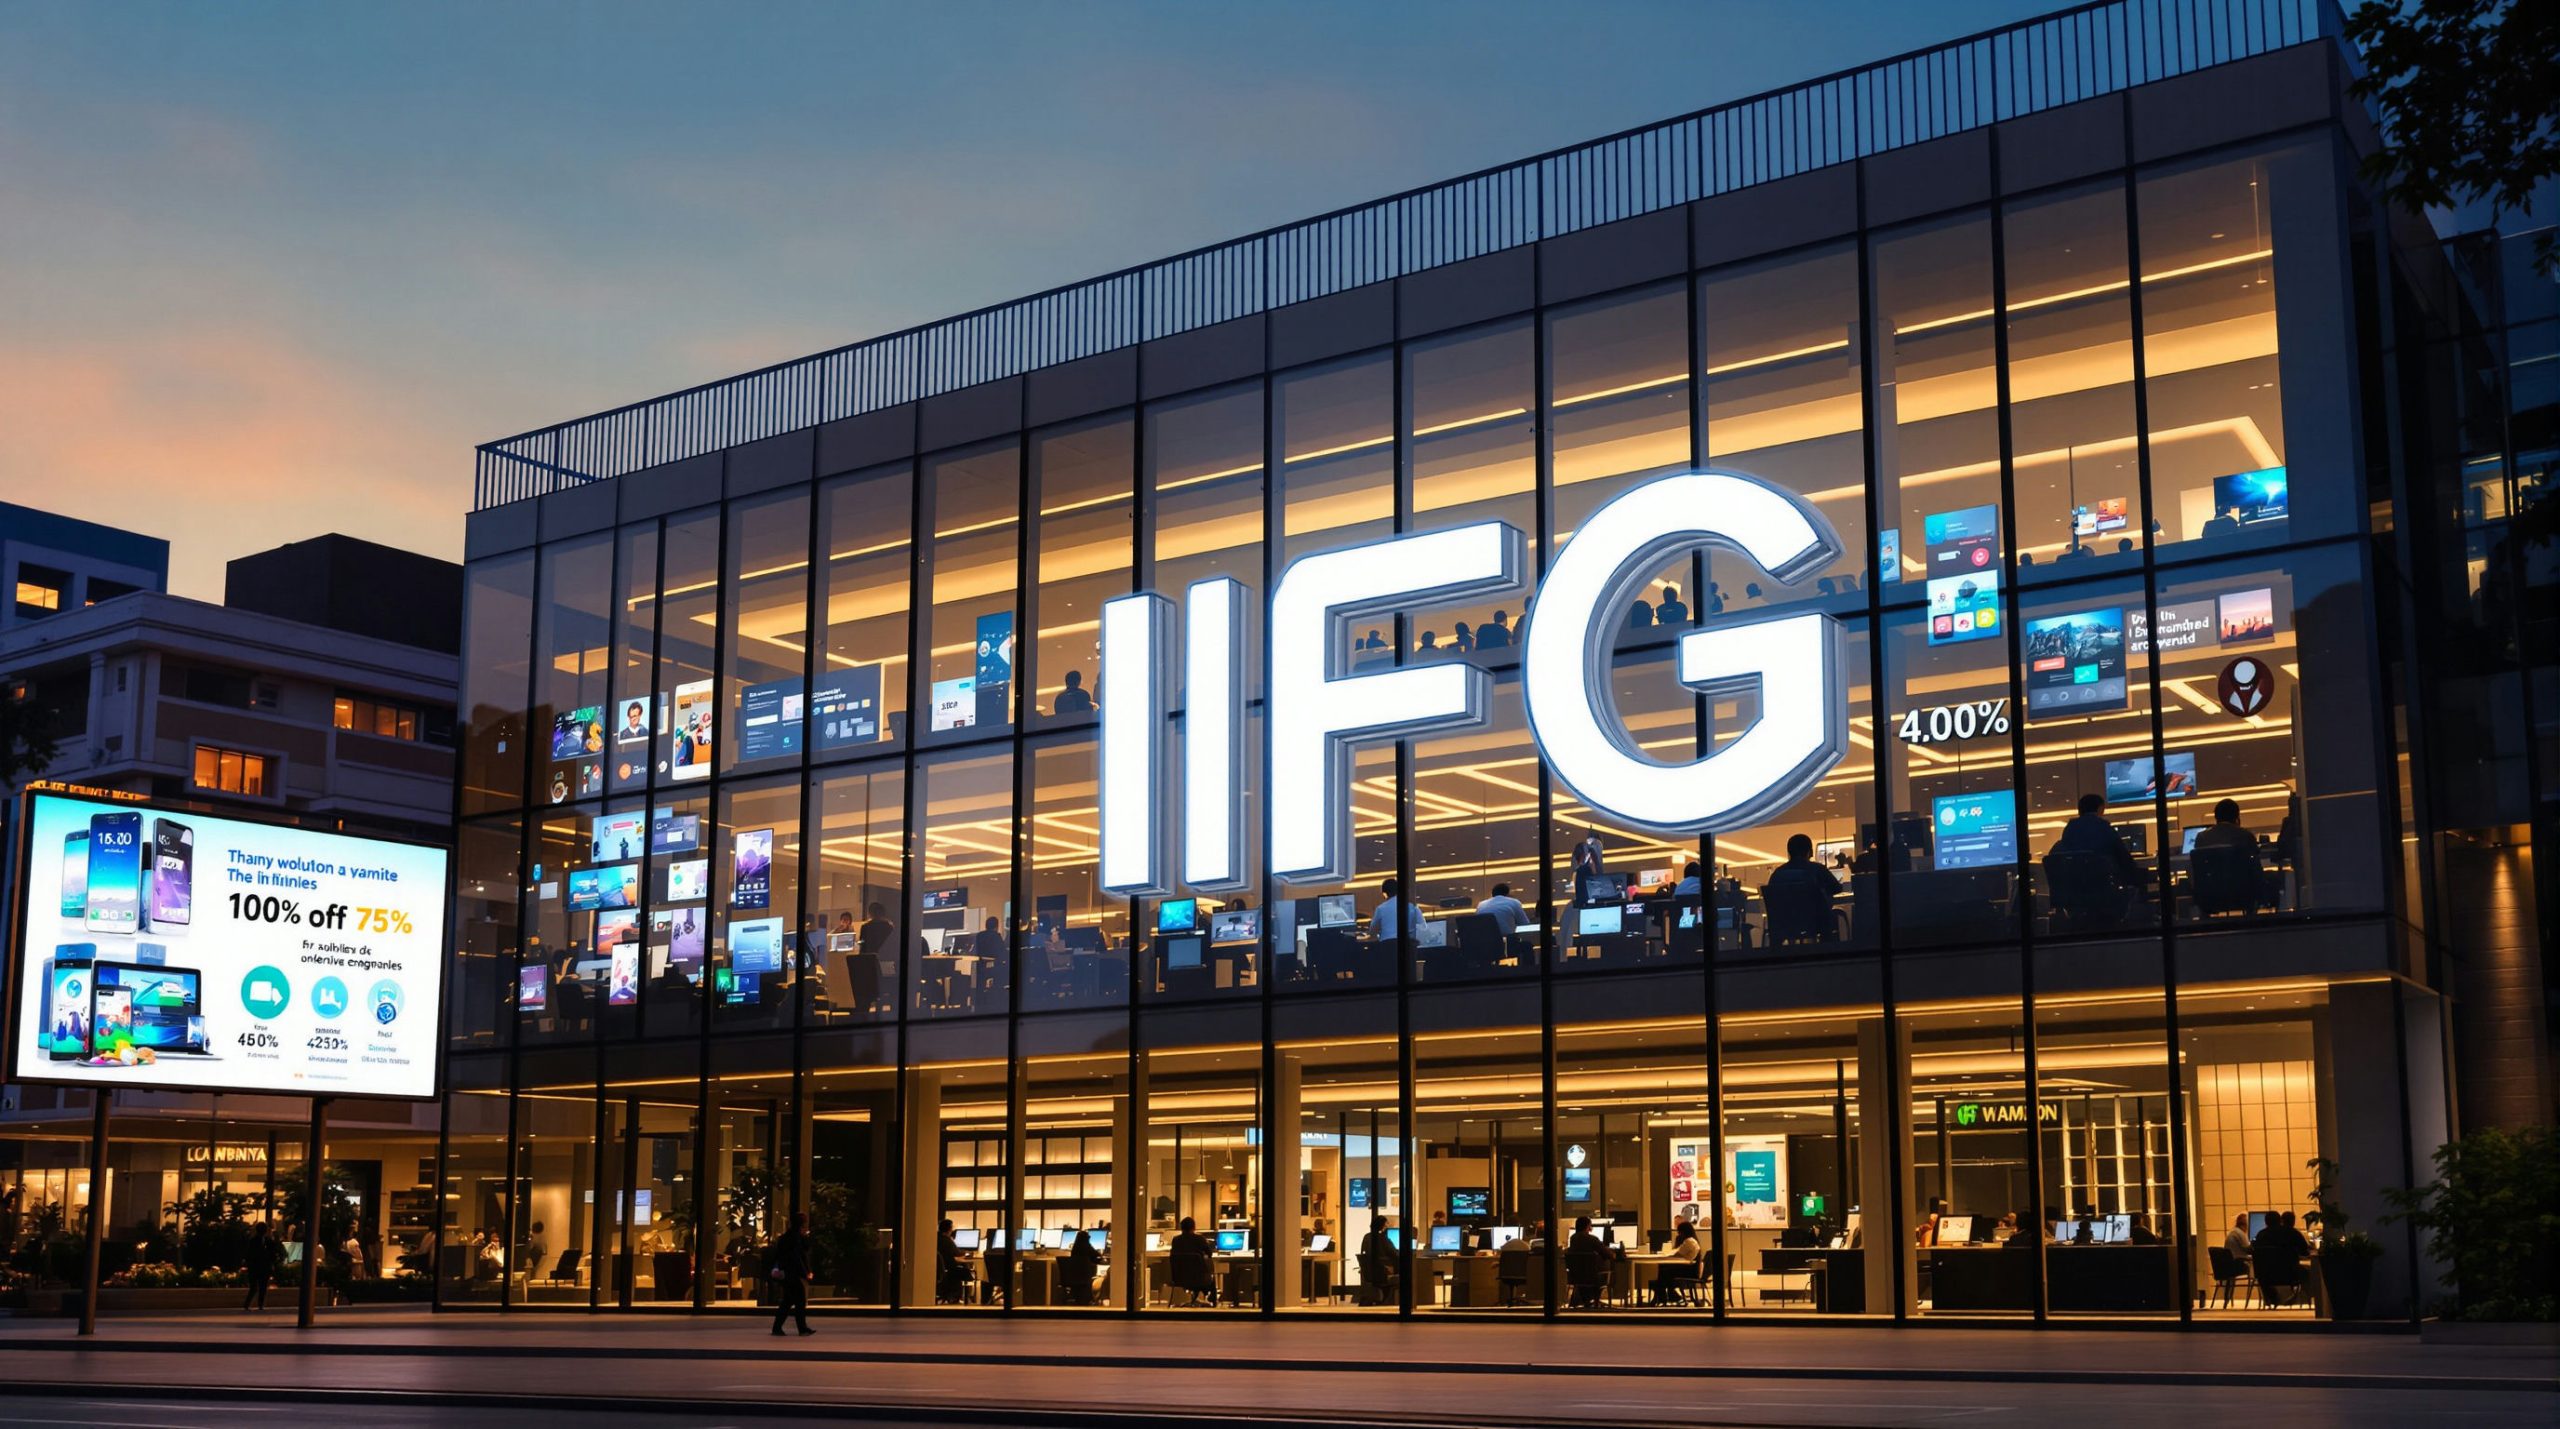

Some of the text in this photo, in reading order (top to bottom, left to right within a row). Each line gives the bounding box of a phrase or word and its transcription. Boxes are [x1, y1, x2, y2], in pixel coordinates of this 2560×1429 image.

[1899, 698, 2010, 743] 4.00%
[227, 868, 253, 884] The
[229, 893, 413, 934] 100% off 75%
[237, 1032, 279, 1048] 450%
